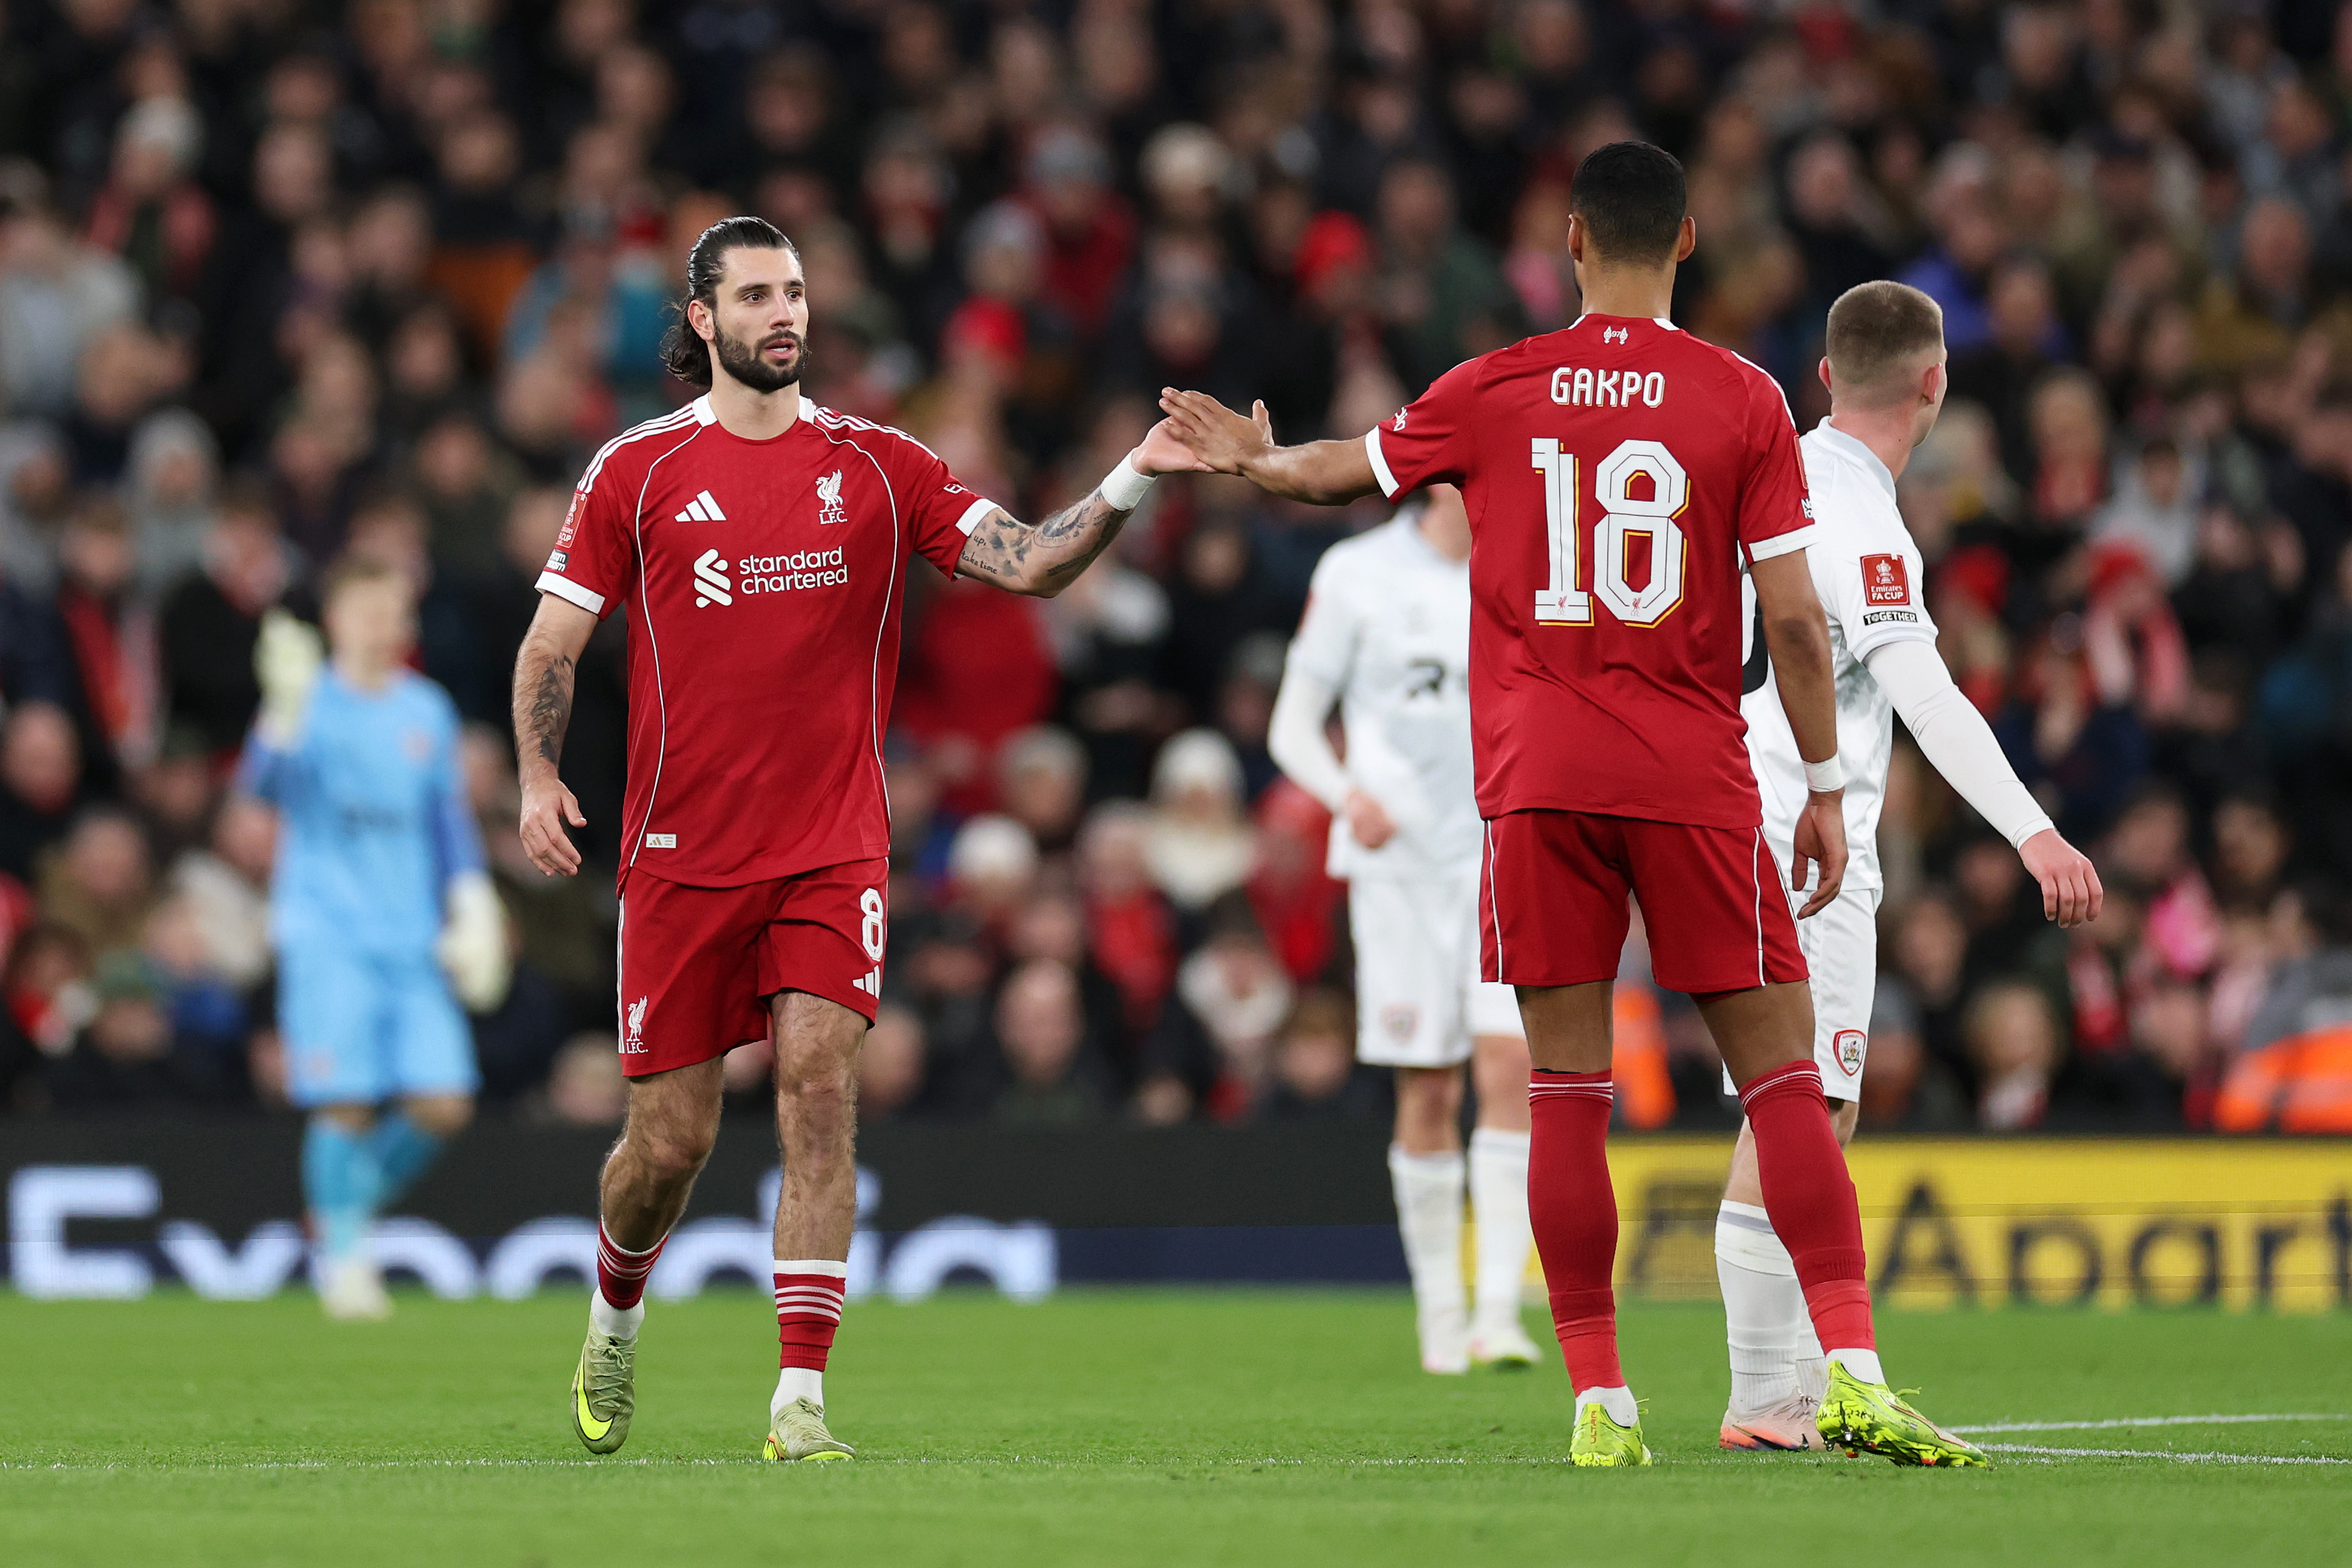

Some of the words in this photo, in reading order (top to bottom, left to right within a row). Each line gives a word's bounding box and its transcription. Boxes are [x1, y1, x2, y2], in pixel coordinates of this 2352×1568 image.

[1551, 367, 1665, 407] GAKPO
[819, 511, 847, 524] L.F.C.
[1531, 438, 1691, 629] 18
[739, 546, 842, 575] standard
[741, 565, 848, 594] chartered
[1871, 585, 1902, 593] Emirates
[1884, 592, 1904, 600] CUP
[1865, 612, 1916, 624] TOGETHER
[860, 888, 883, 961] 8
